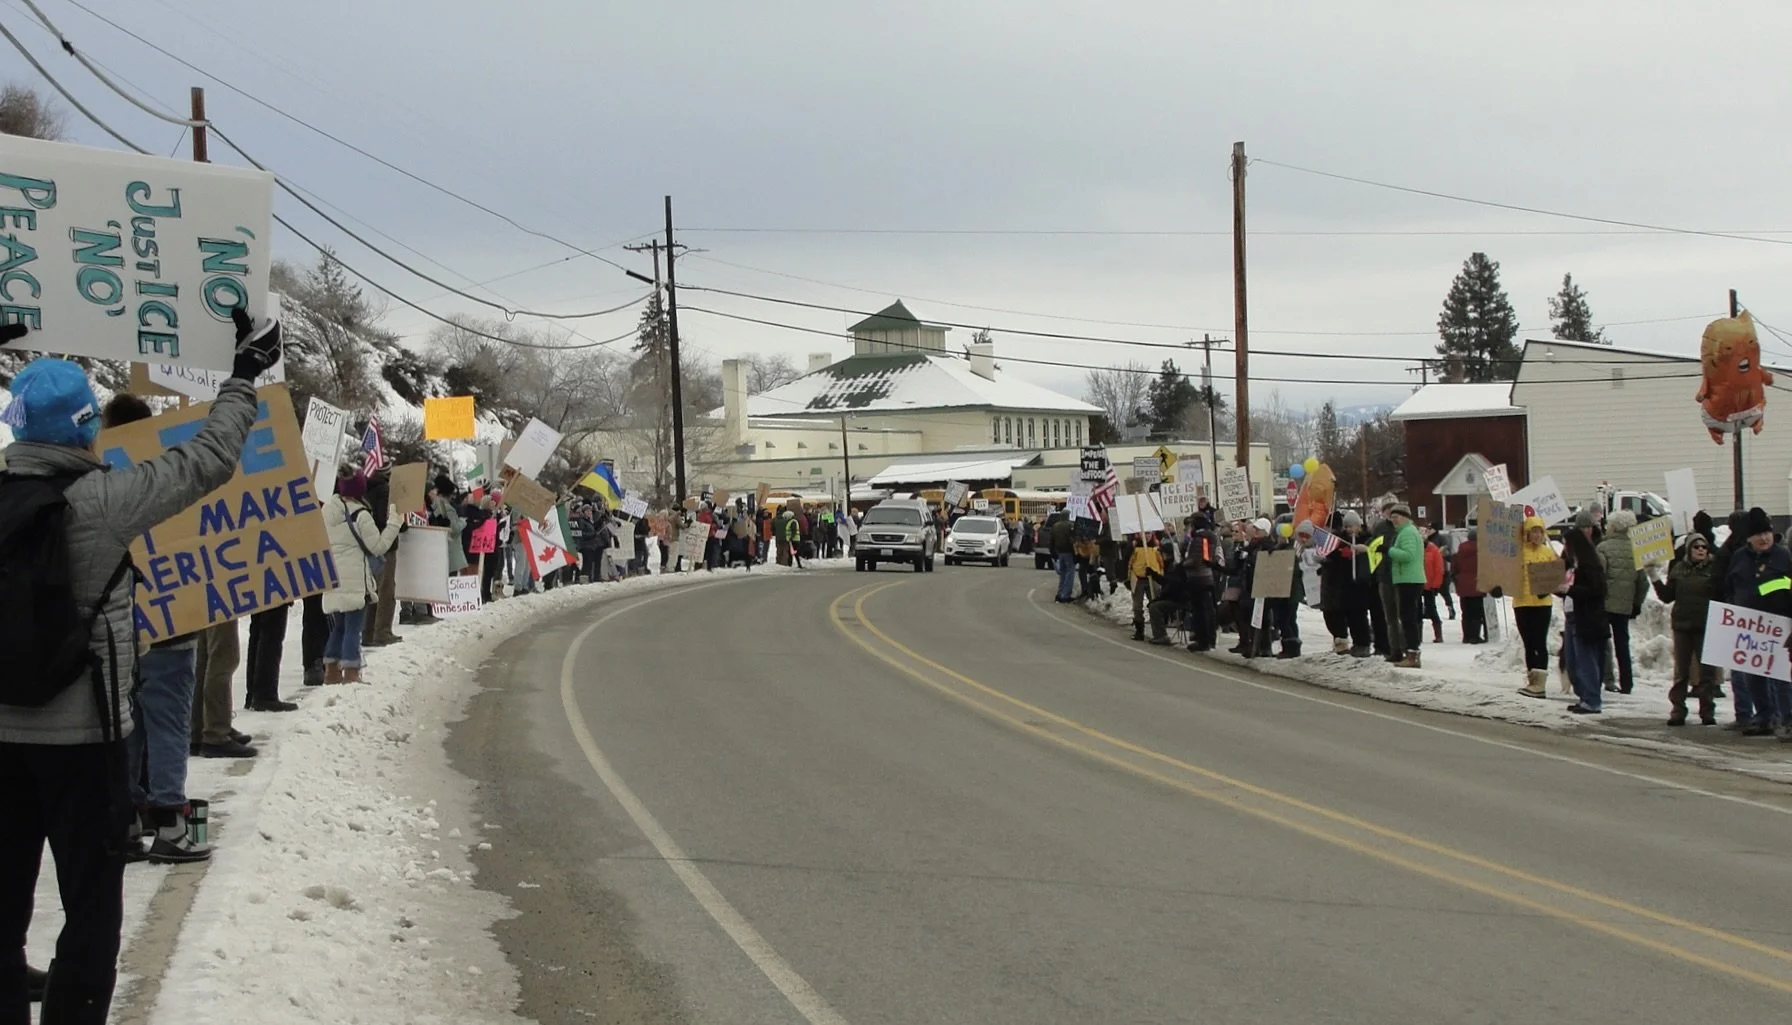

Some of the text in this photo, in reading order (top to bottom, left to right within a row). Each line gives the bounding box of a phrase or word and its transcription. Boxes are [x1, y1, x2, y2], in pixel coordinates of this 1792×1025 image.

[310, 401, 342, 427] PROTECT
[1084, 461, 1100, 470] THE
[1164, 483, 1194, 495] ICE IS
[200, 477, 318, 536] MAKE
[134, 530, 287, 593] ERICA
[206, 550, 341, 624] AGAIN!
[450, 579, 477, 590] Stand
[1721, 608, 1783, 637] Barbie
[1733, 650, 1775, 675] GO!
